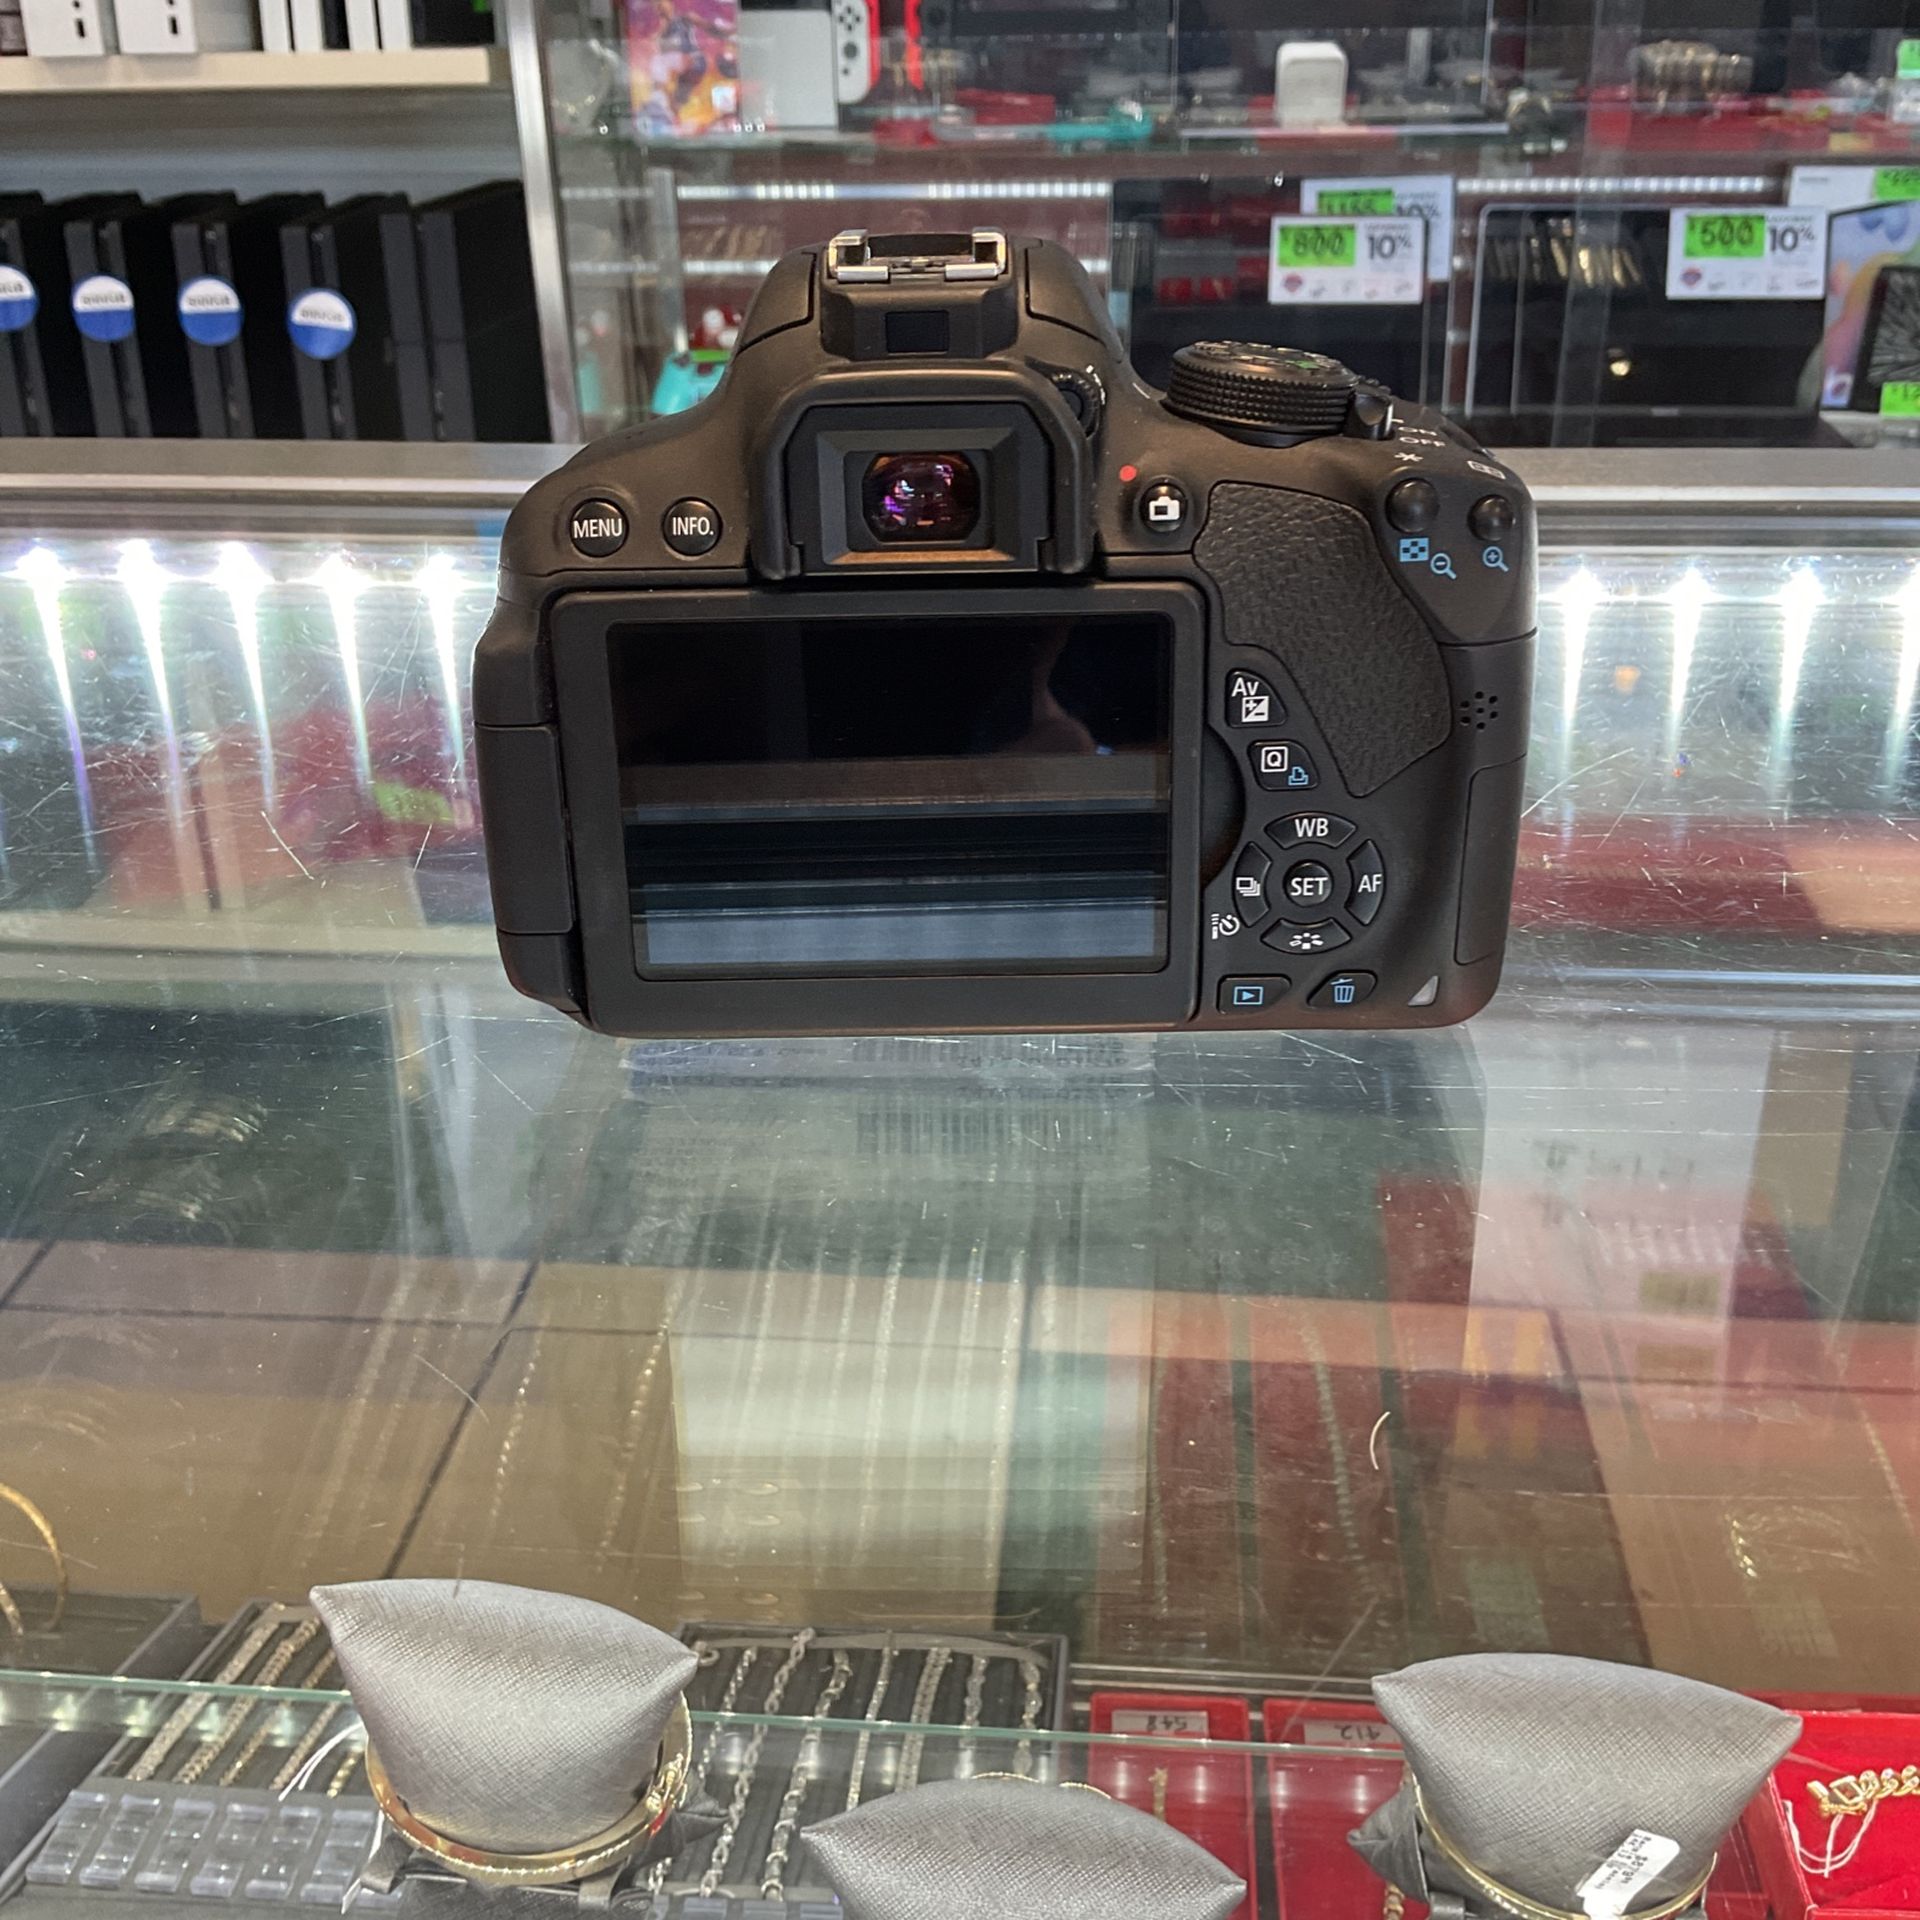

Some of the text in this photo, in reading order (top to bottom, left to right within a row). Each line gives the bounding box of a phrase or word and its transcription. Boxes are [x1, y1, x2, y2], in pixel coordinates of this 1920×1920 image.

[1399, 436, 1446, 448] OFF
[573, 518, 623, 539] MENU
[672, 516, 714, 536] INFO.
[1231, 677, 1260, 698] Av
[1267, 751, 1282, 768] Q
[1294, 817, 1330, 838] WB
[1290, 876, 1329, 896] SET
[1357, 873, 1383, 893] AF
